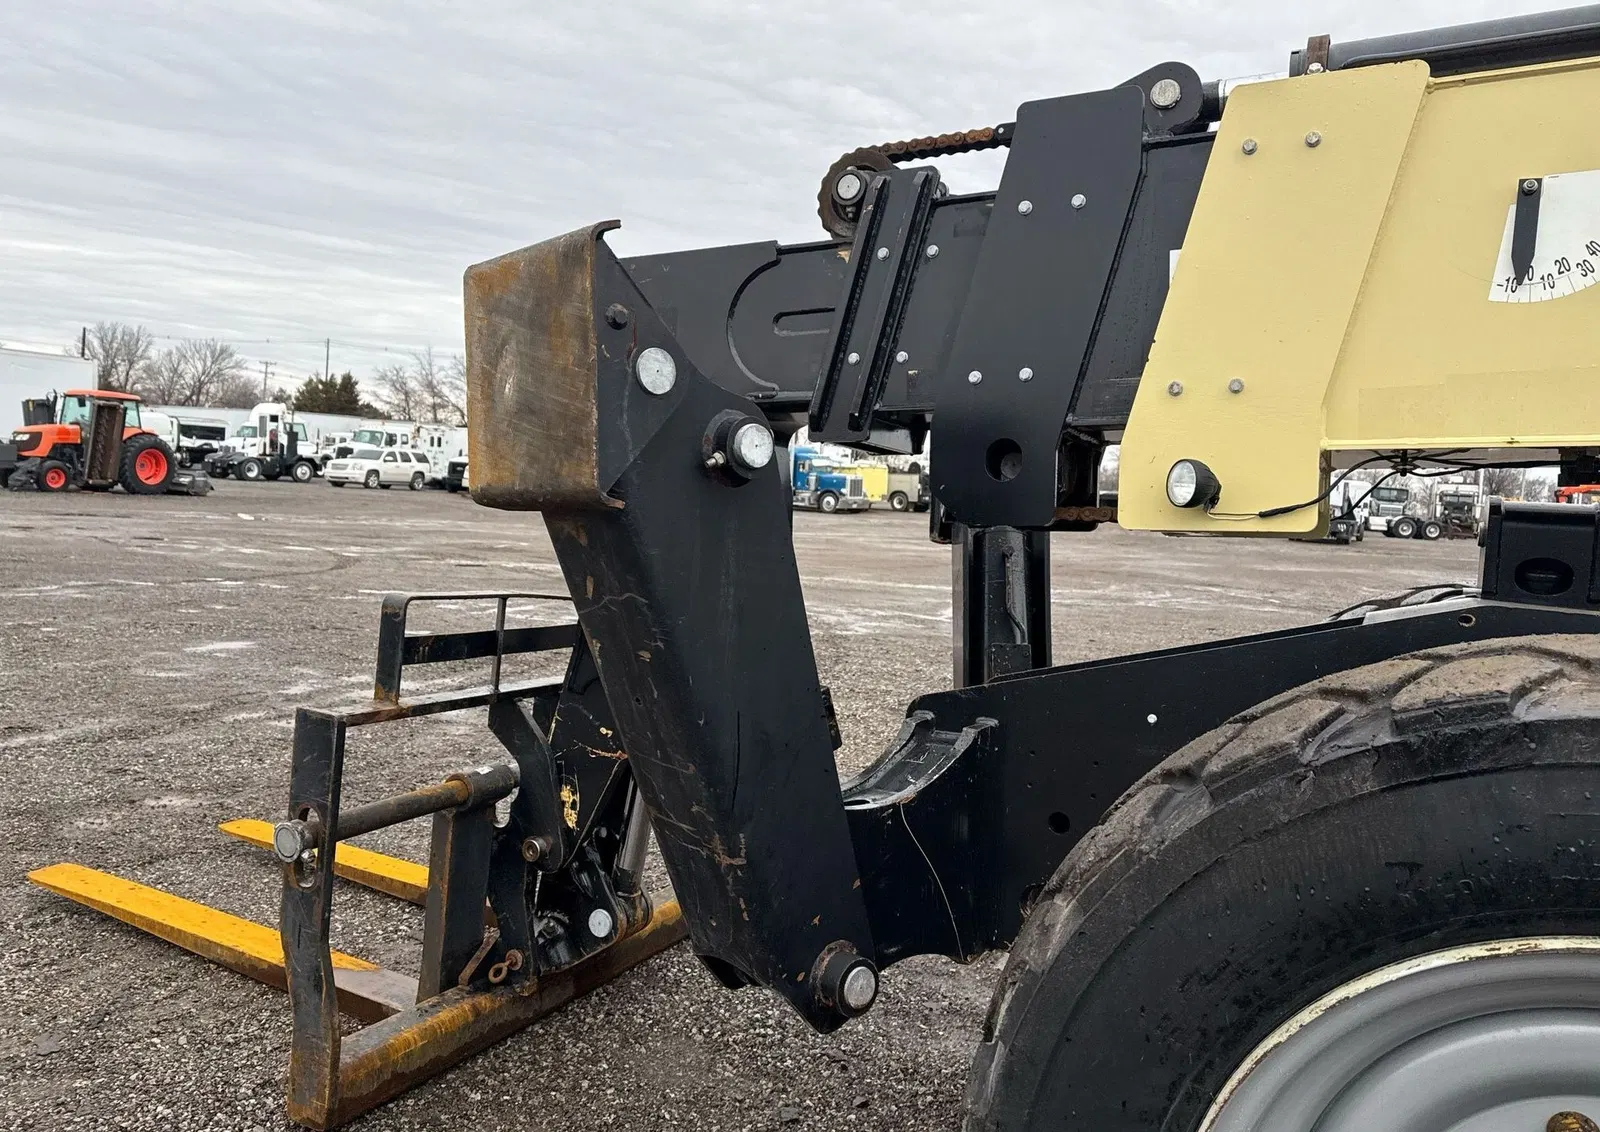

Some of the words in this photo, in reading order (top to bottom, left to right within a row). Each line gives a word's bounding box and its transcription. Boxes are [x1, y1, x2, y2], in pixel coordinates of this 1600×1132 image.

[1527, 265, 1534, 281] 0
[1540, 273, 1555, 290] 10
[1554, 257, 1571, 275] 20
[1576, 259, 1595, 277] 30
